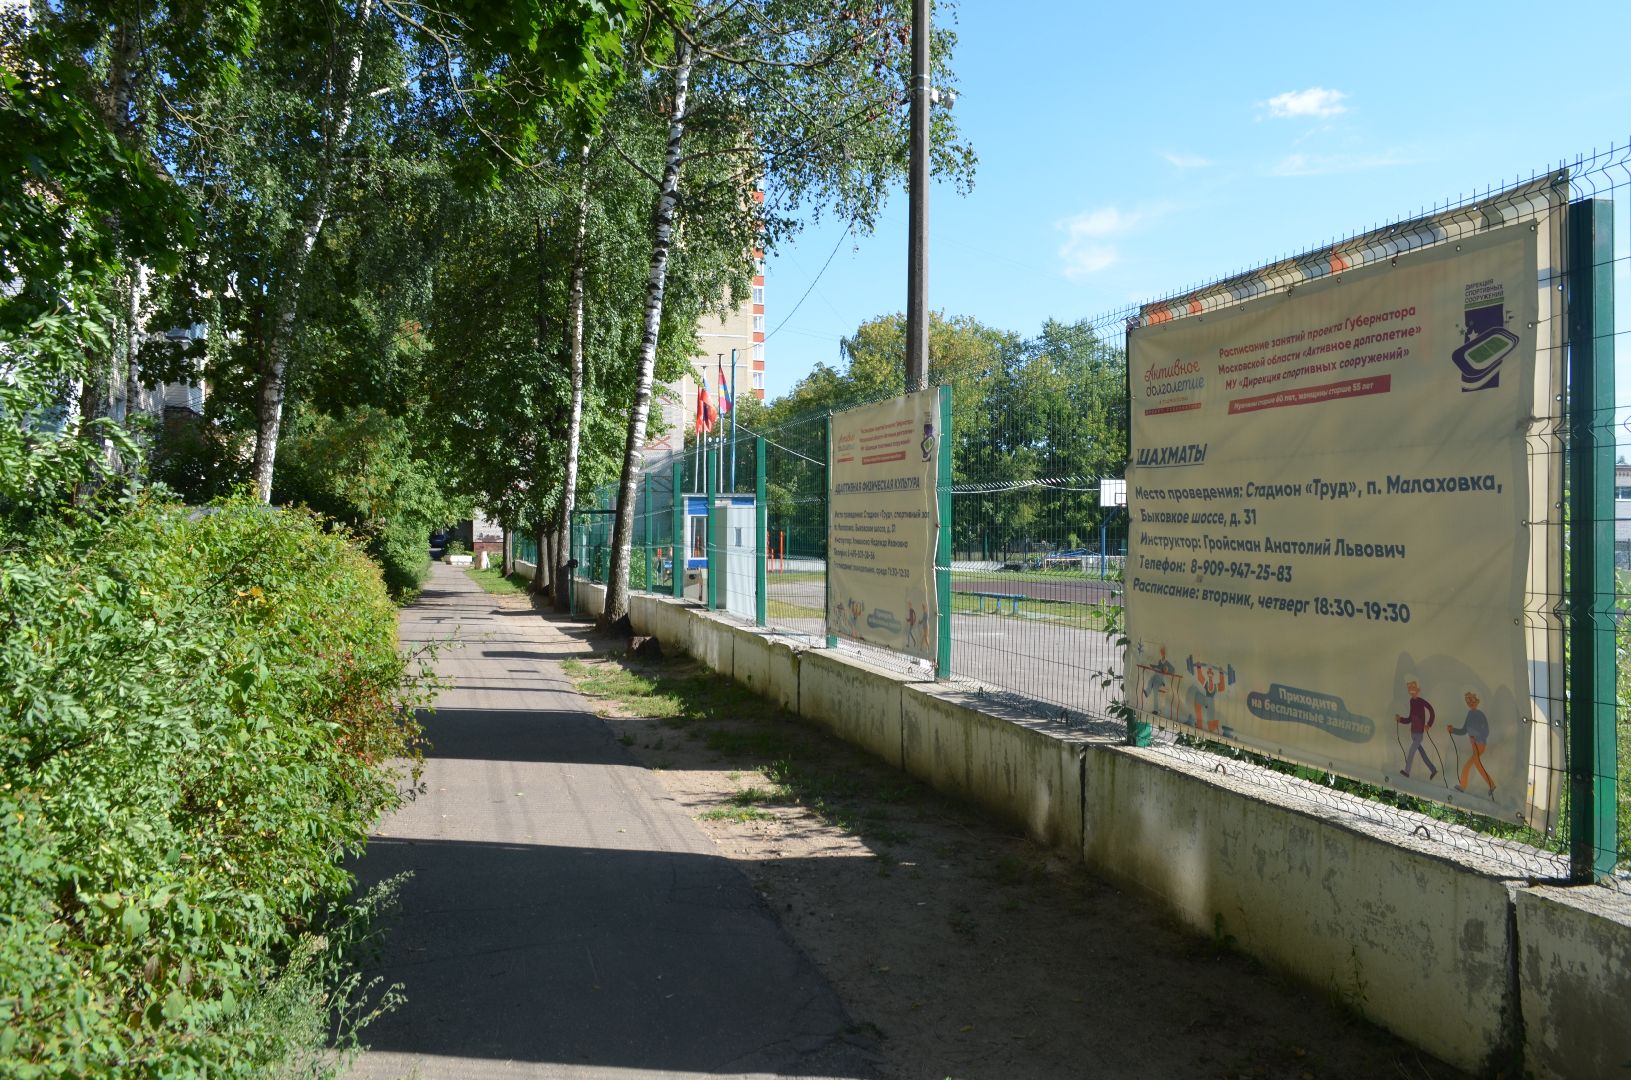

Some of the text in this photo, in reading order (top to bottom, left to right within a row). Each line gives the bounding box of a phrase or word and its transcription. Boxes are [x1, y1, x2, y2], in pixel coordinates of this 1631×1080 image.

[1219, 306, 1416, 358] Расписание занятий проекта Губернатора
[1218, 325, 1422, 375] Московской области «Активное долголетие»
[1144, 358, 1201, 382] Активное
[1225, 346, 1410, 390] МУ «Дирекция спортивных сооружений»
[1146, 376, 1205, 397] долголетие
[1352, 382, 1361, 392] 55
[1135, 443, 1208, 466] ШАХМАТЫ
[1135, 474, 1502, 503] Место проведения: Стадион «Труд», п. Малаховка,
[1140, 508, 1257, 527] Быковкое шоссе, д. 31
[1140, 531, 1406, 559] Инструктор: Гройсман Анатолий Львович
[1139, 554, 1292, 583] Телефон: 8-909-947-25-83
[1133, 577, 1411, 623] Расписание: вторник, четверг 18:30-19:30
[1278, 687, 1338, 711] Приходите
[1251, 698, 1371, 736] на бесплатные занятия
